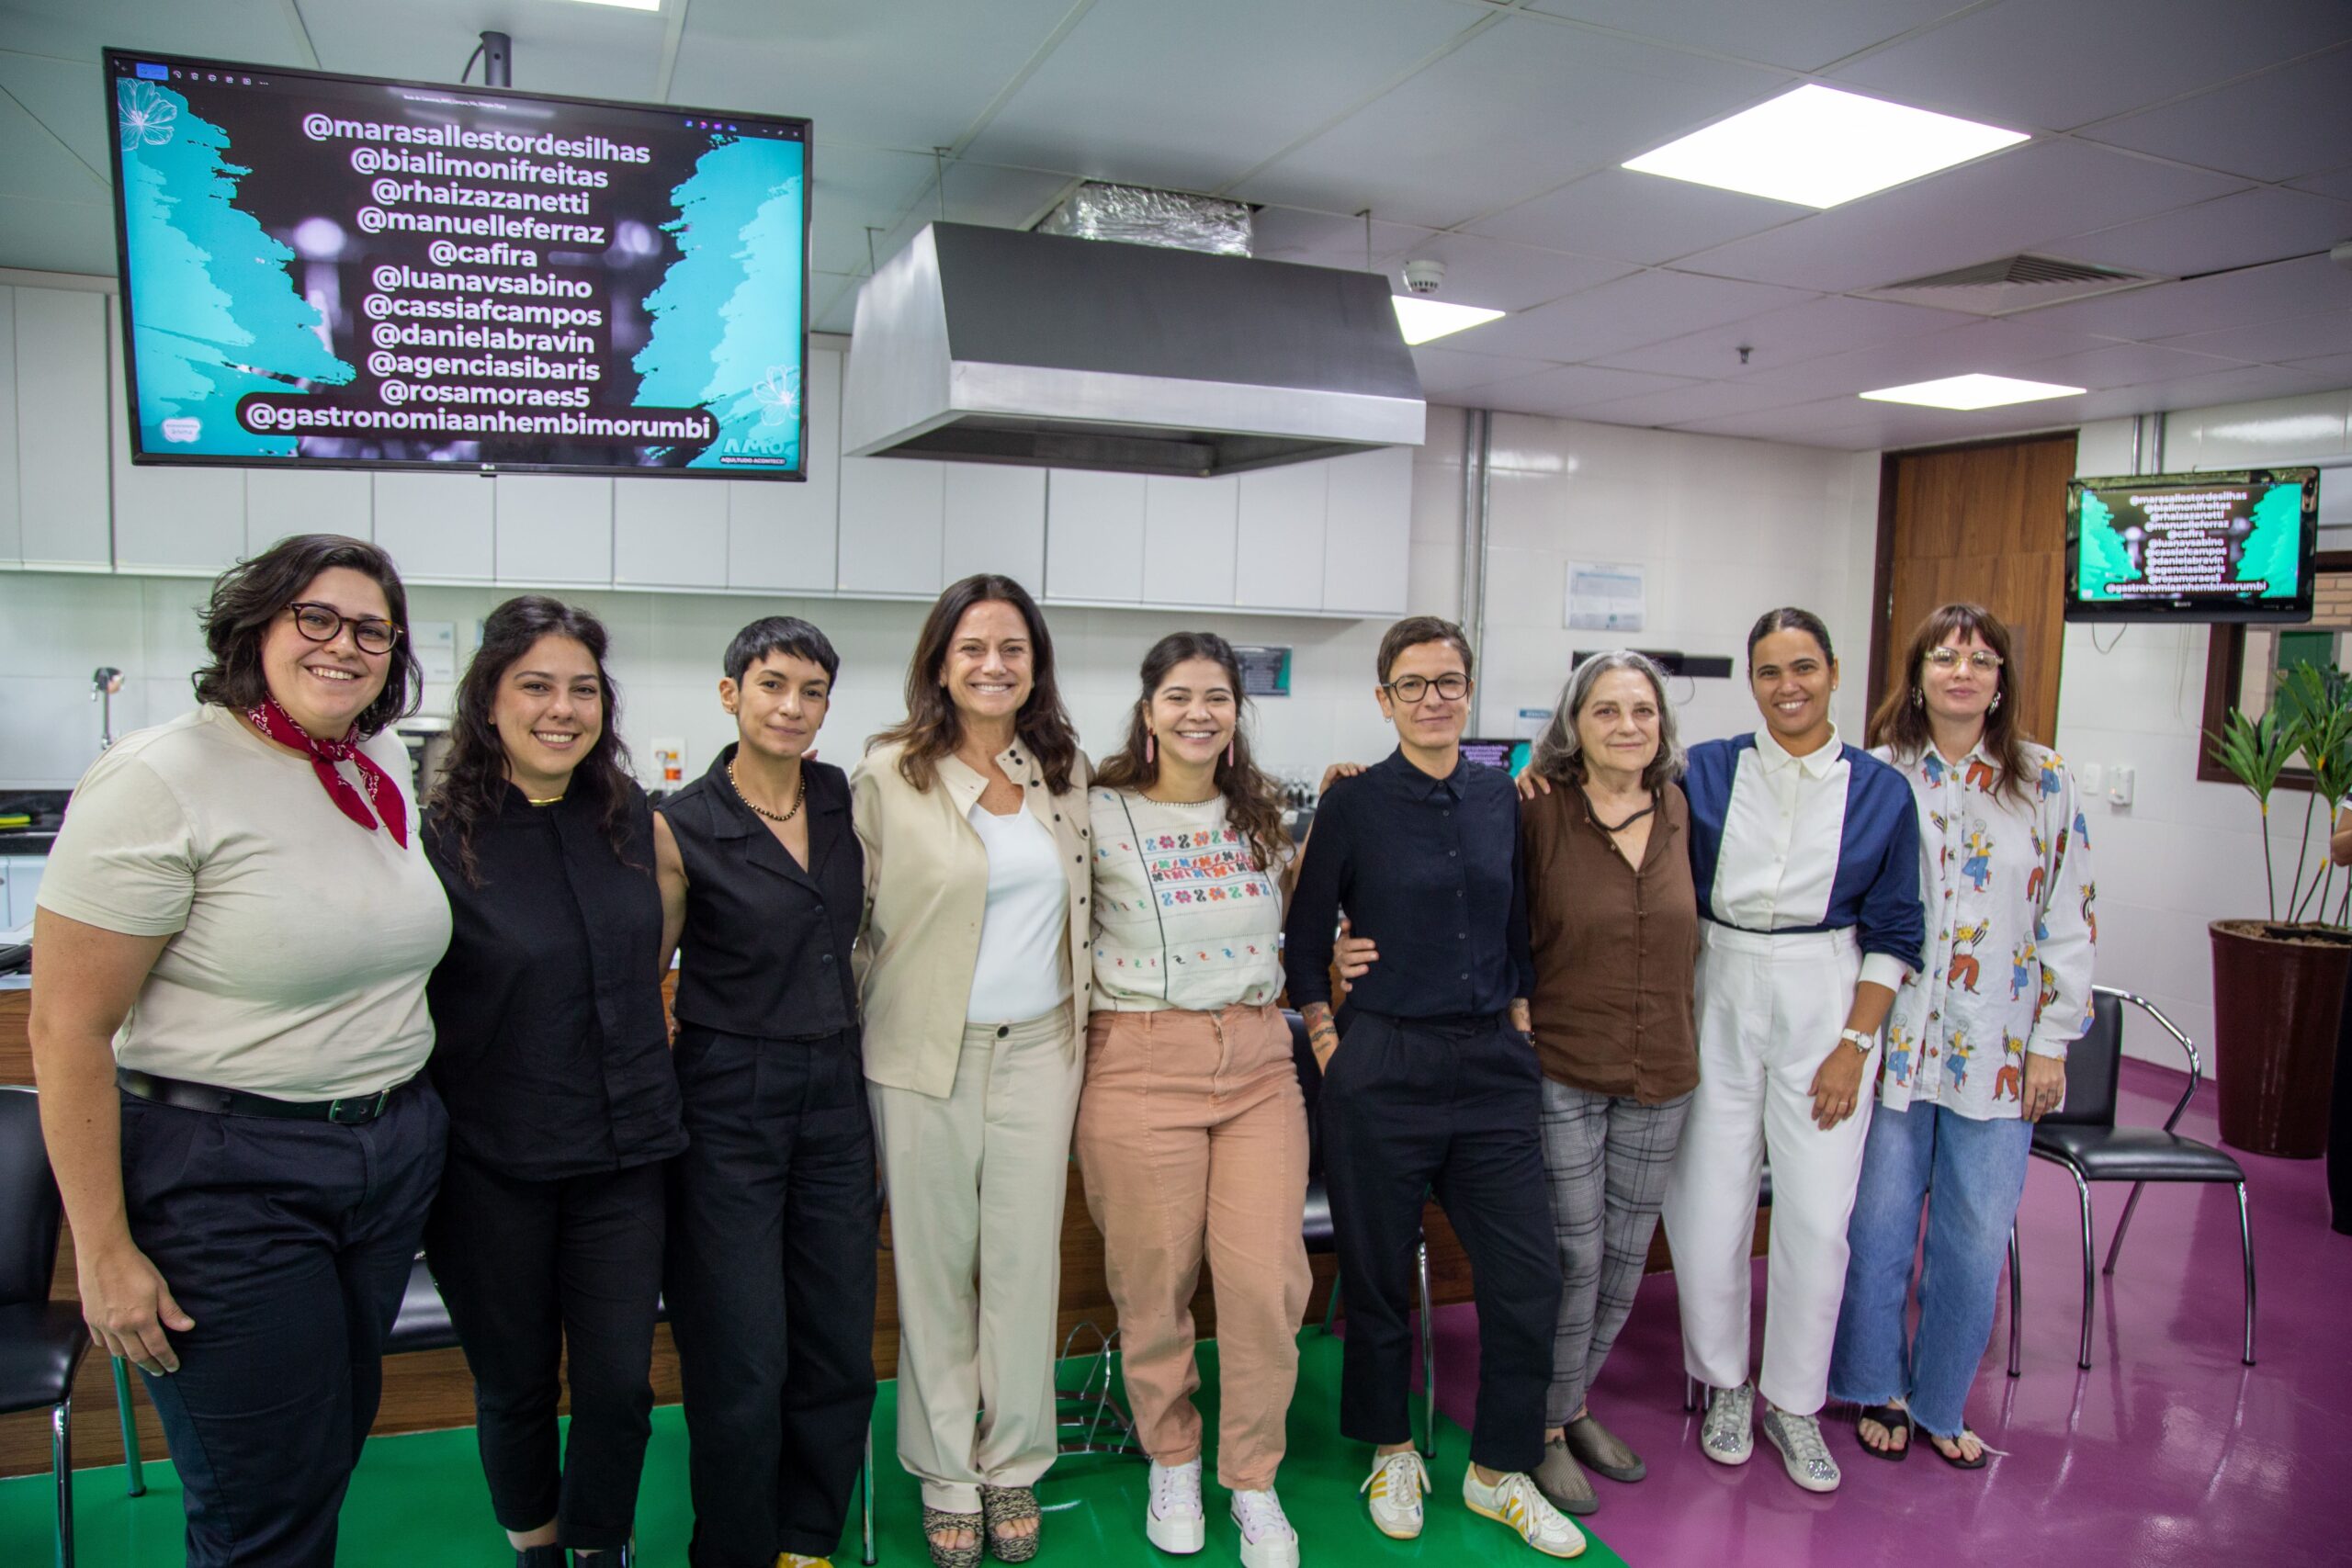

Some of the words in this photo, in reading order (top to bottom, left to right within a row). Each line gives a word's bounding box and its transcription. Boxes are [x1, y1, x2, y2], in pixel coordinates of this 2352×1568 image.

[302, 113, 651, 165] @marasallestordesilhas
[350, 147, 609, 188] @bialimonifreitas
[371, 178, 590, 215] @rhaizazanetti
[356, 207, 605, 243] @manuelleferraz
[428, 240, 538, 267] @cafira
[371, 265, 593, 299] @luanavsabino
[363, 293, 603, 329] @cassiafcampos
[371, 322, 595, 354] @danielabravin
[367, 350, 602, 381] @agenciasibaris
[379, 378, 591, 408] @rosamoraes5
[245, 402, 711, 440] @gastronomiaanhembimorumbi
